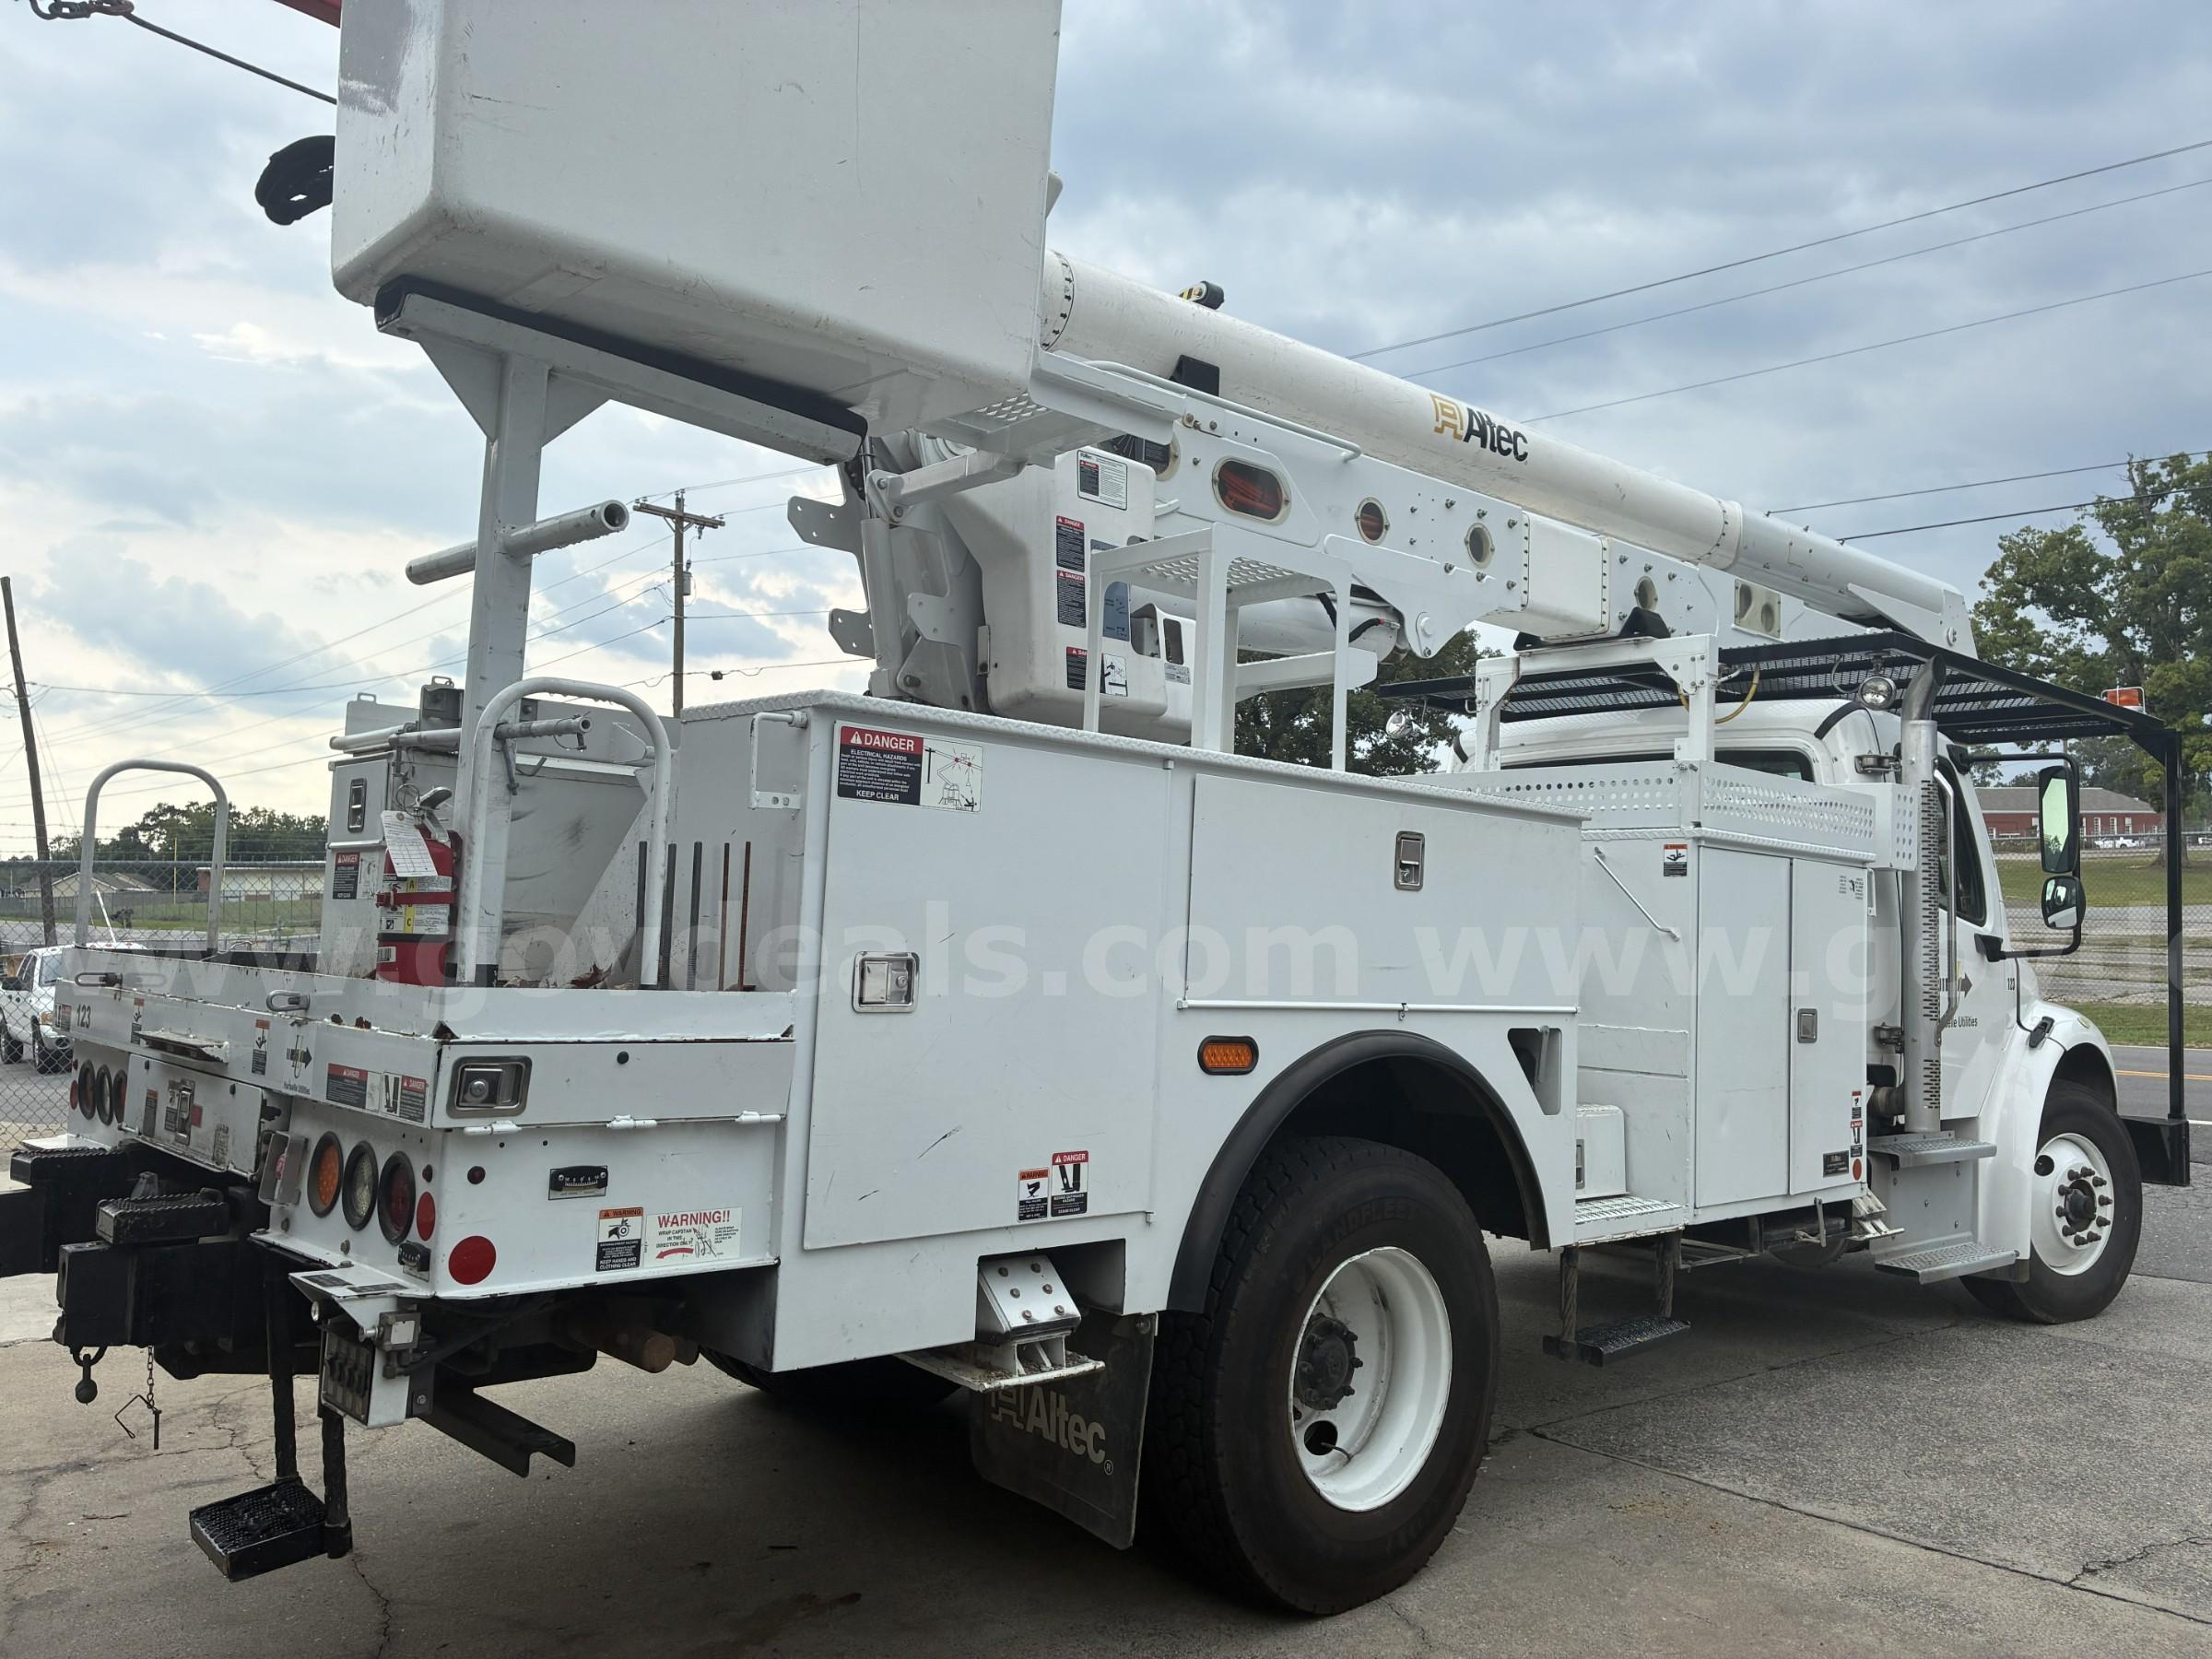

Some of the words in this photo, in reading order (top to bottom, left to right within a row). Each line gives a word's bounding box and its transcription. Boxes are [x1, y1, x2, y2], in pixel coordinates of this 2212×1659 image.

[1464, 407, 1529, 462] Altec
[1065, 572, 1084, 582] DANGER
[865, 734, 915, 751] DANGER
[851, 749, 882, 758] ELECTRICAL
[856, 790, 876, 798] KEEP
[342, 854, 358, 863] DANGER
[406, 918, 411, 926] C
[76, 1004, 91, 1029] 123
[1958, 1016, 1978, 1028] Utilities
[1063, 1154, 1086, 1162] DANGER
[613, 1208, 641, 1217] WARNING
[657, 1209, 731, 1229] WARNING!!
[1025, 1384, 1106, 1465] Altec
